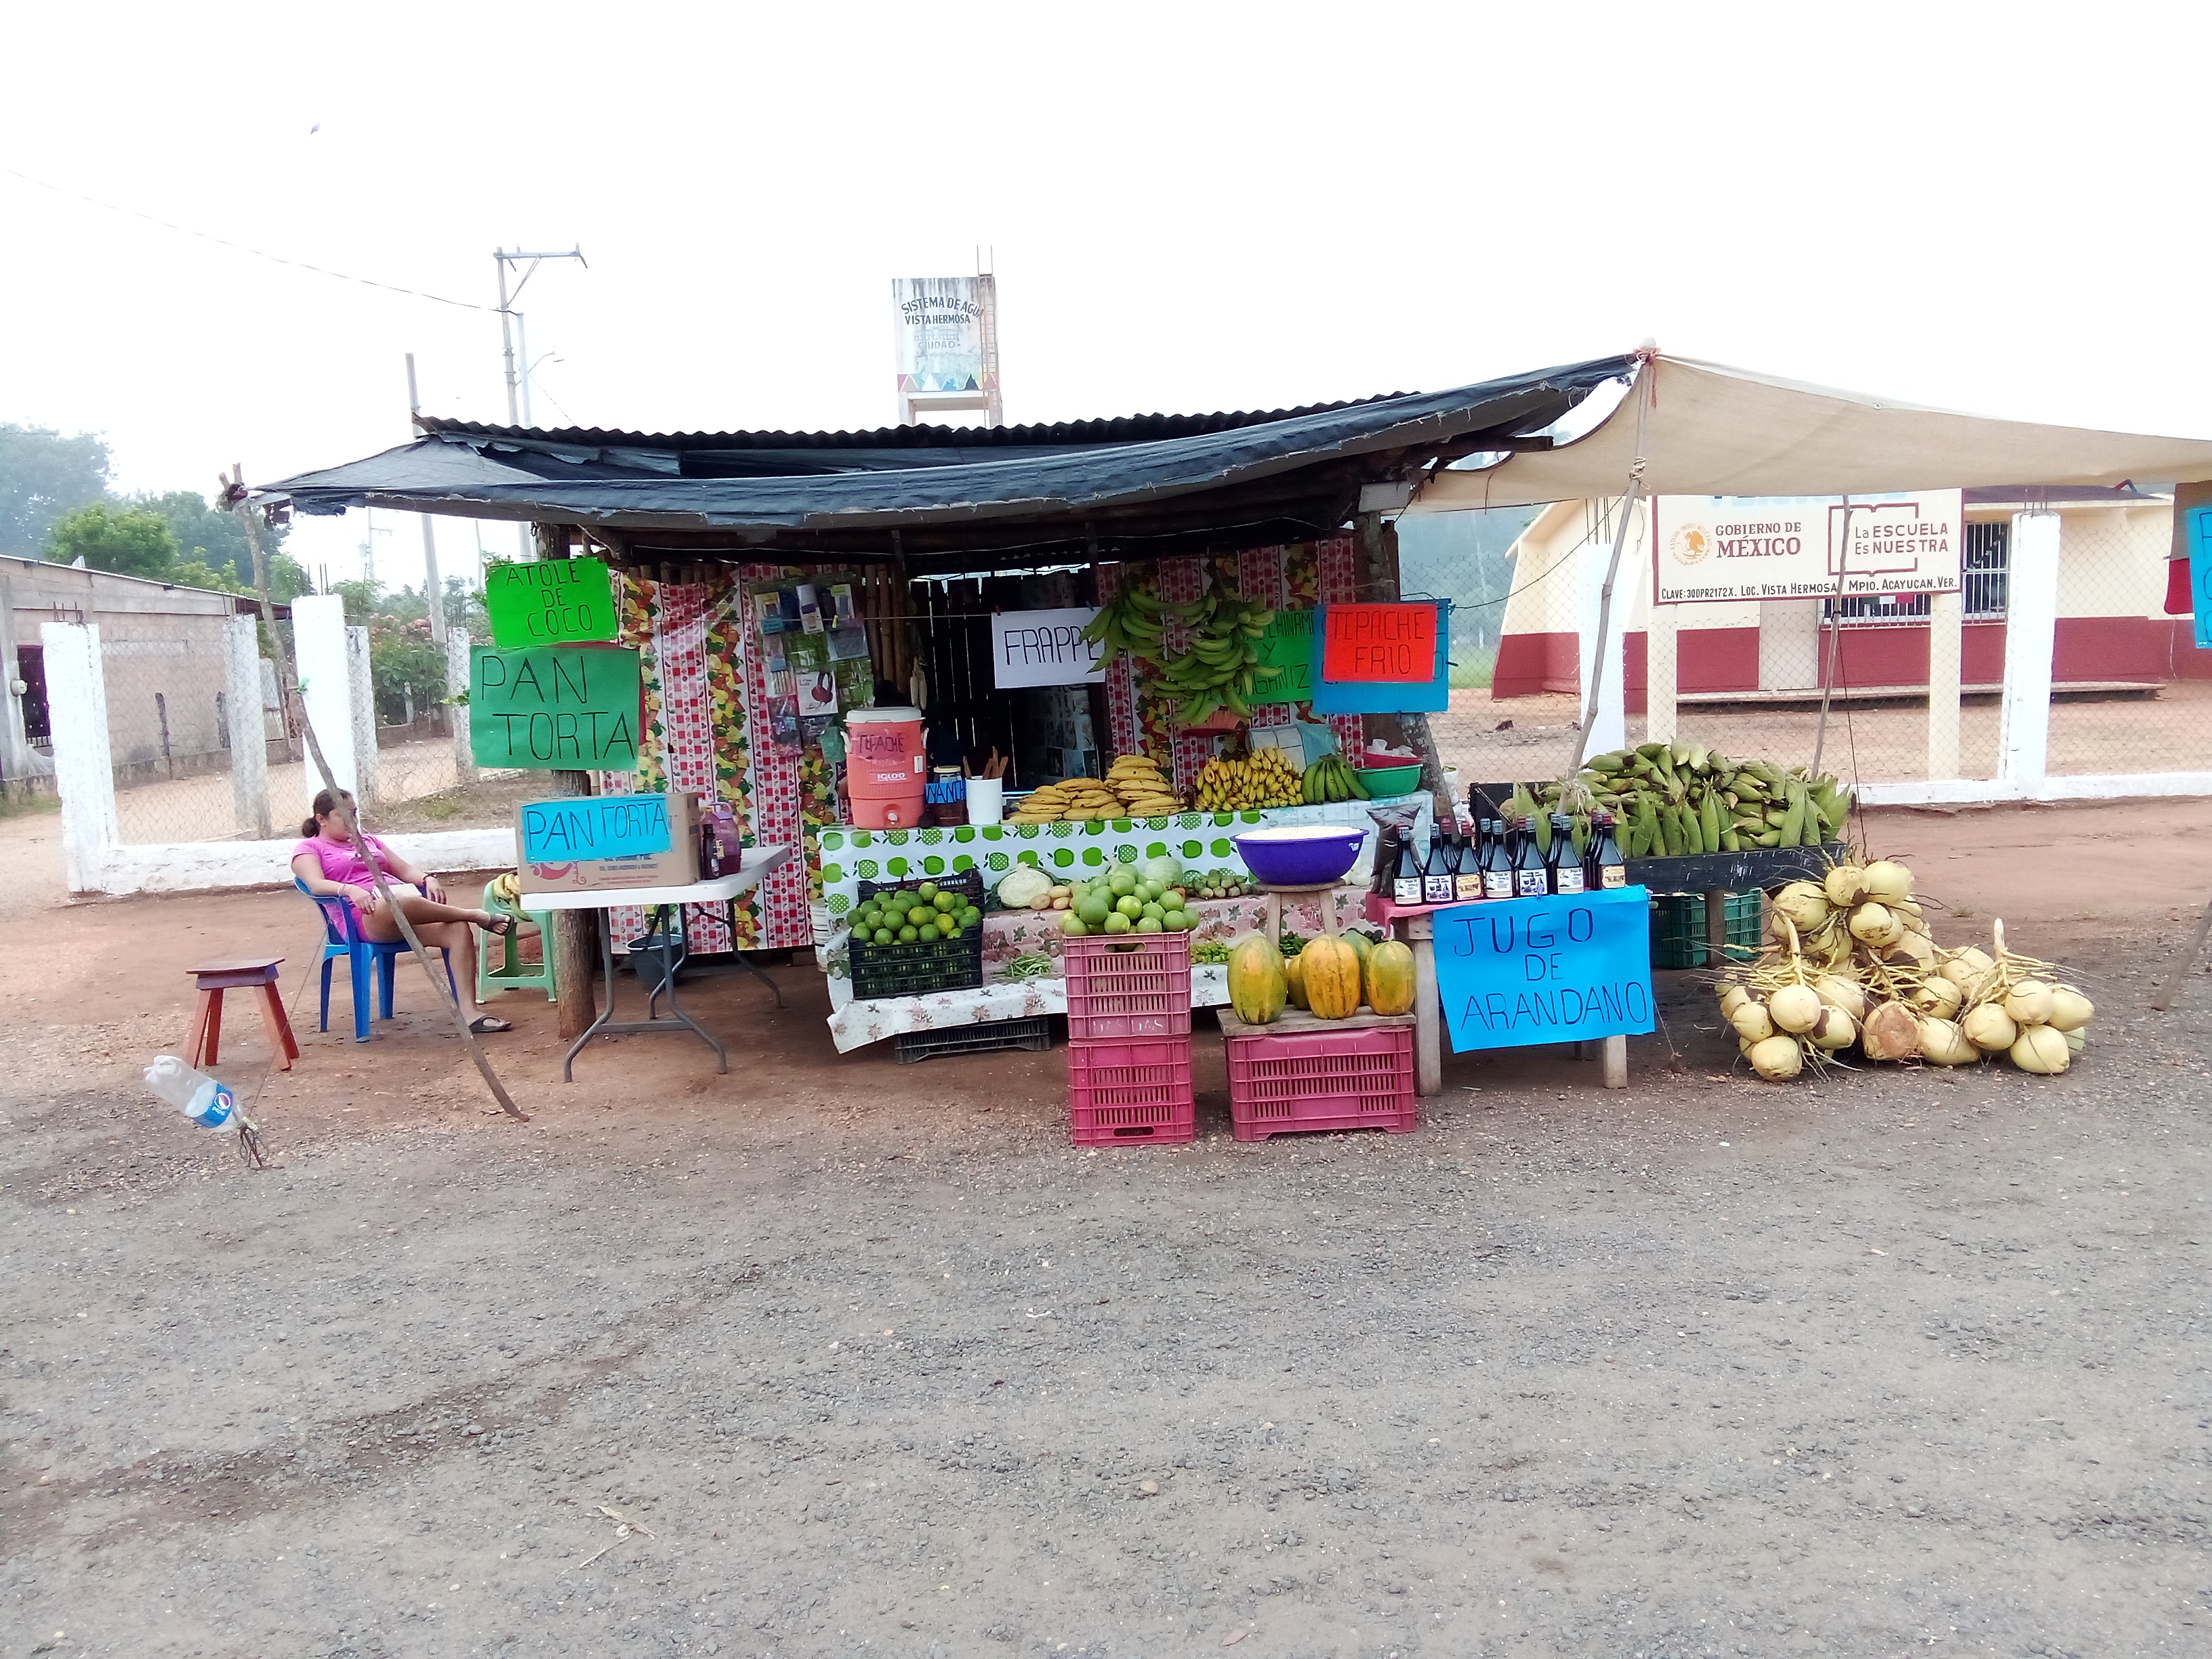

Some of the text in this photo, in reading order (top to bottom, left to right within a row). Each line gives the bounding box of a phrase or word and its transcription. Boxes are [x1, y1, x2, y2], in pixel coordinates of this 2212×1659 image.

[901, 296, 944, 314] SISTEMA
[947, 297, 960, 310] DE
[905, 314, 971, 325] VISTA HERMOSA
[1715, 523, 1780, 536] GOBIERNO
[1785, 522, 1801, 533] DE
[1856, 523, 1948, 539] La ESCUELA
[1716, 535, 1801, 558] MÉXICO
[1855, 539, 1948, 554] Es NUESTRA
[506, 561, 580, 587] ATOLE
[541, 588, 567, 608] DE
[1761, 583, 1787, 595] VISTA
[1790, 583, 1837, 594] HERMOSA
[1849, 580, 1879, 592] MPIO.
[527, 605, 594, 637] COCO
[1262, 641, 1276, 661] Y
[1355, 644, 1411, 674] FRIO
[482, 655, 588, 704] PAN
[492, 711, 636, 760] TORTA
[857, 734, 905, 754] TEPACHE
[878, 773, 906, 781] IGLOO
[527, 802, 669, 851] PAN TORTA
[1453, 908, 1594, 957] JUGO
[1525, 953, 1563, 981] DE
[1460, 981, 1647, 1031] ARANDANO
